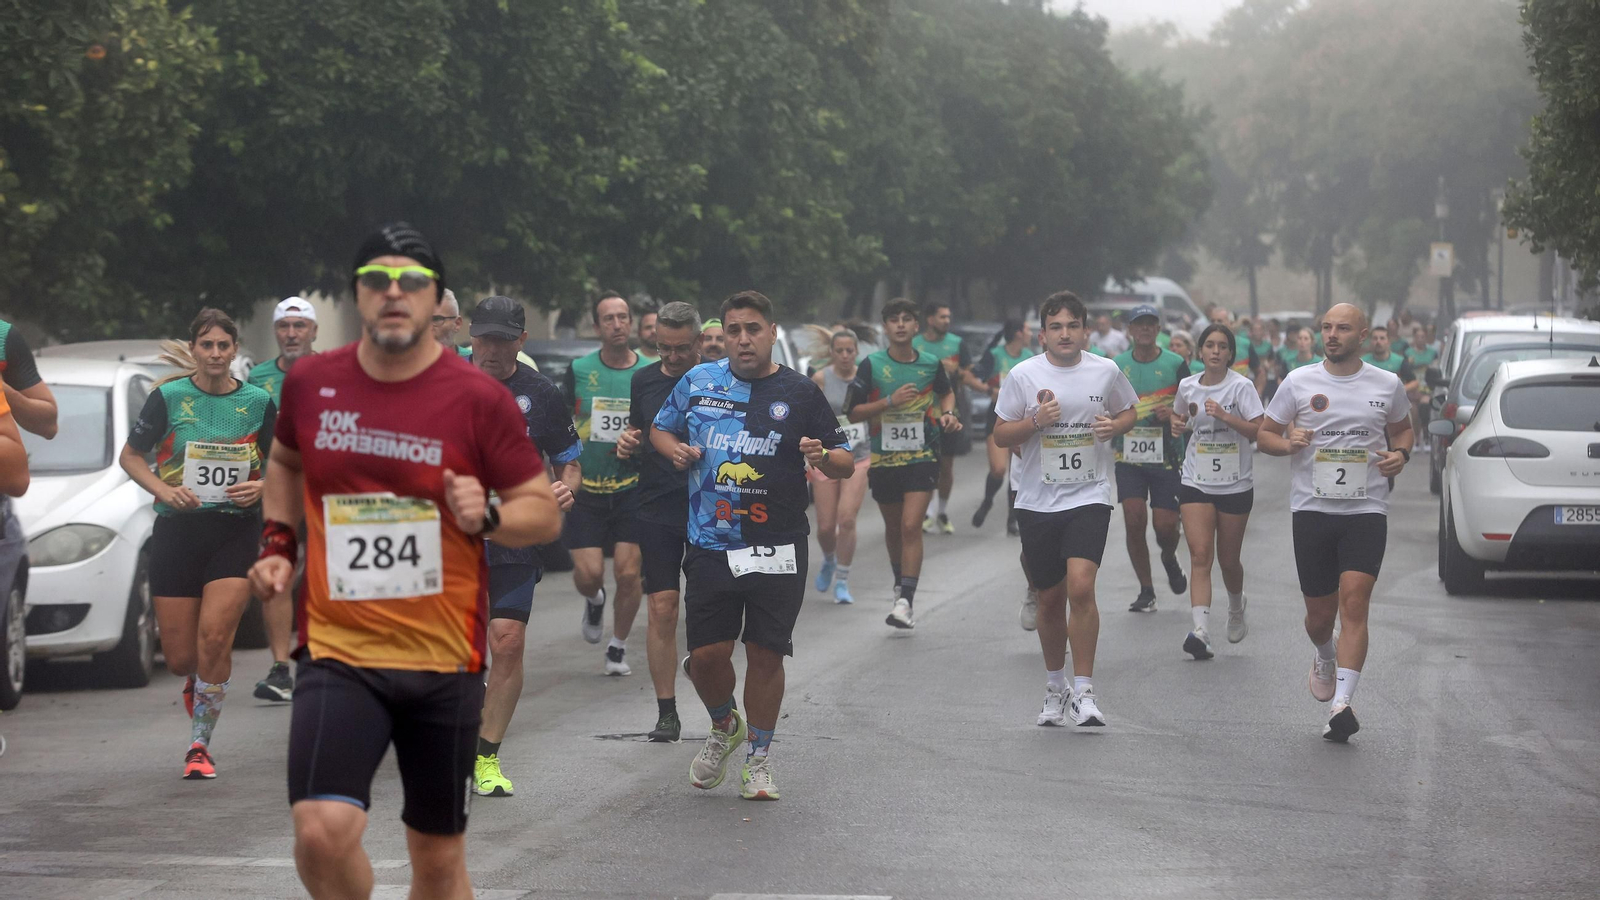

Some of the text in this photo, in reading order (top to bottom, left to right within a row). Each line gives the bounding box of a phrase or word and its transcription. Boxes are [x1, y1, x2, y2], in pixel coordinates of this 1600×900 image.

[319, 409, 361, 432] 10K
[706, 426, 781, 456] LOS PUPAS
[890, 426, 919, 440] 341
[1130, 440, 1156, 453] 204
[1059, 452, 1082, 470] 16
[1212, 459, 1222, 472] 5
[197, 466, 239, 486] 305
[1335, 468, 1346, 485] 2
[1566, 507, 1600, 522] 2855
[347, 535, 421, 570] 284
